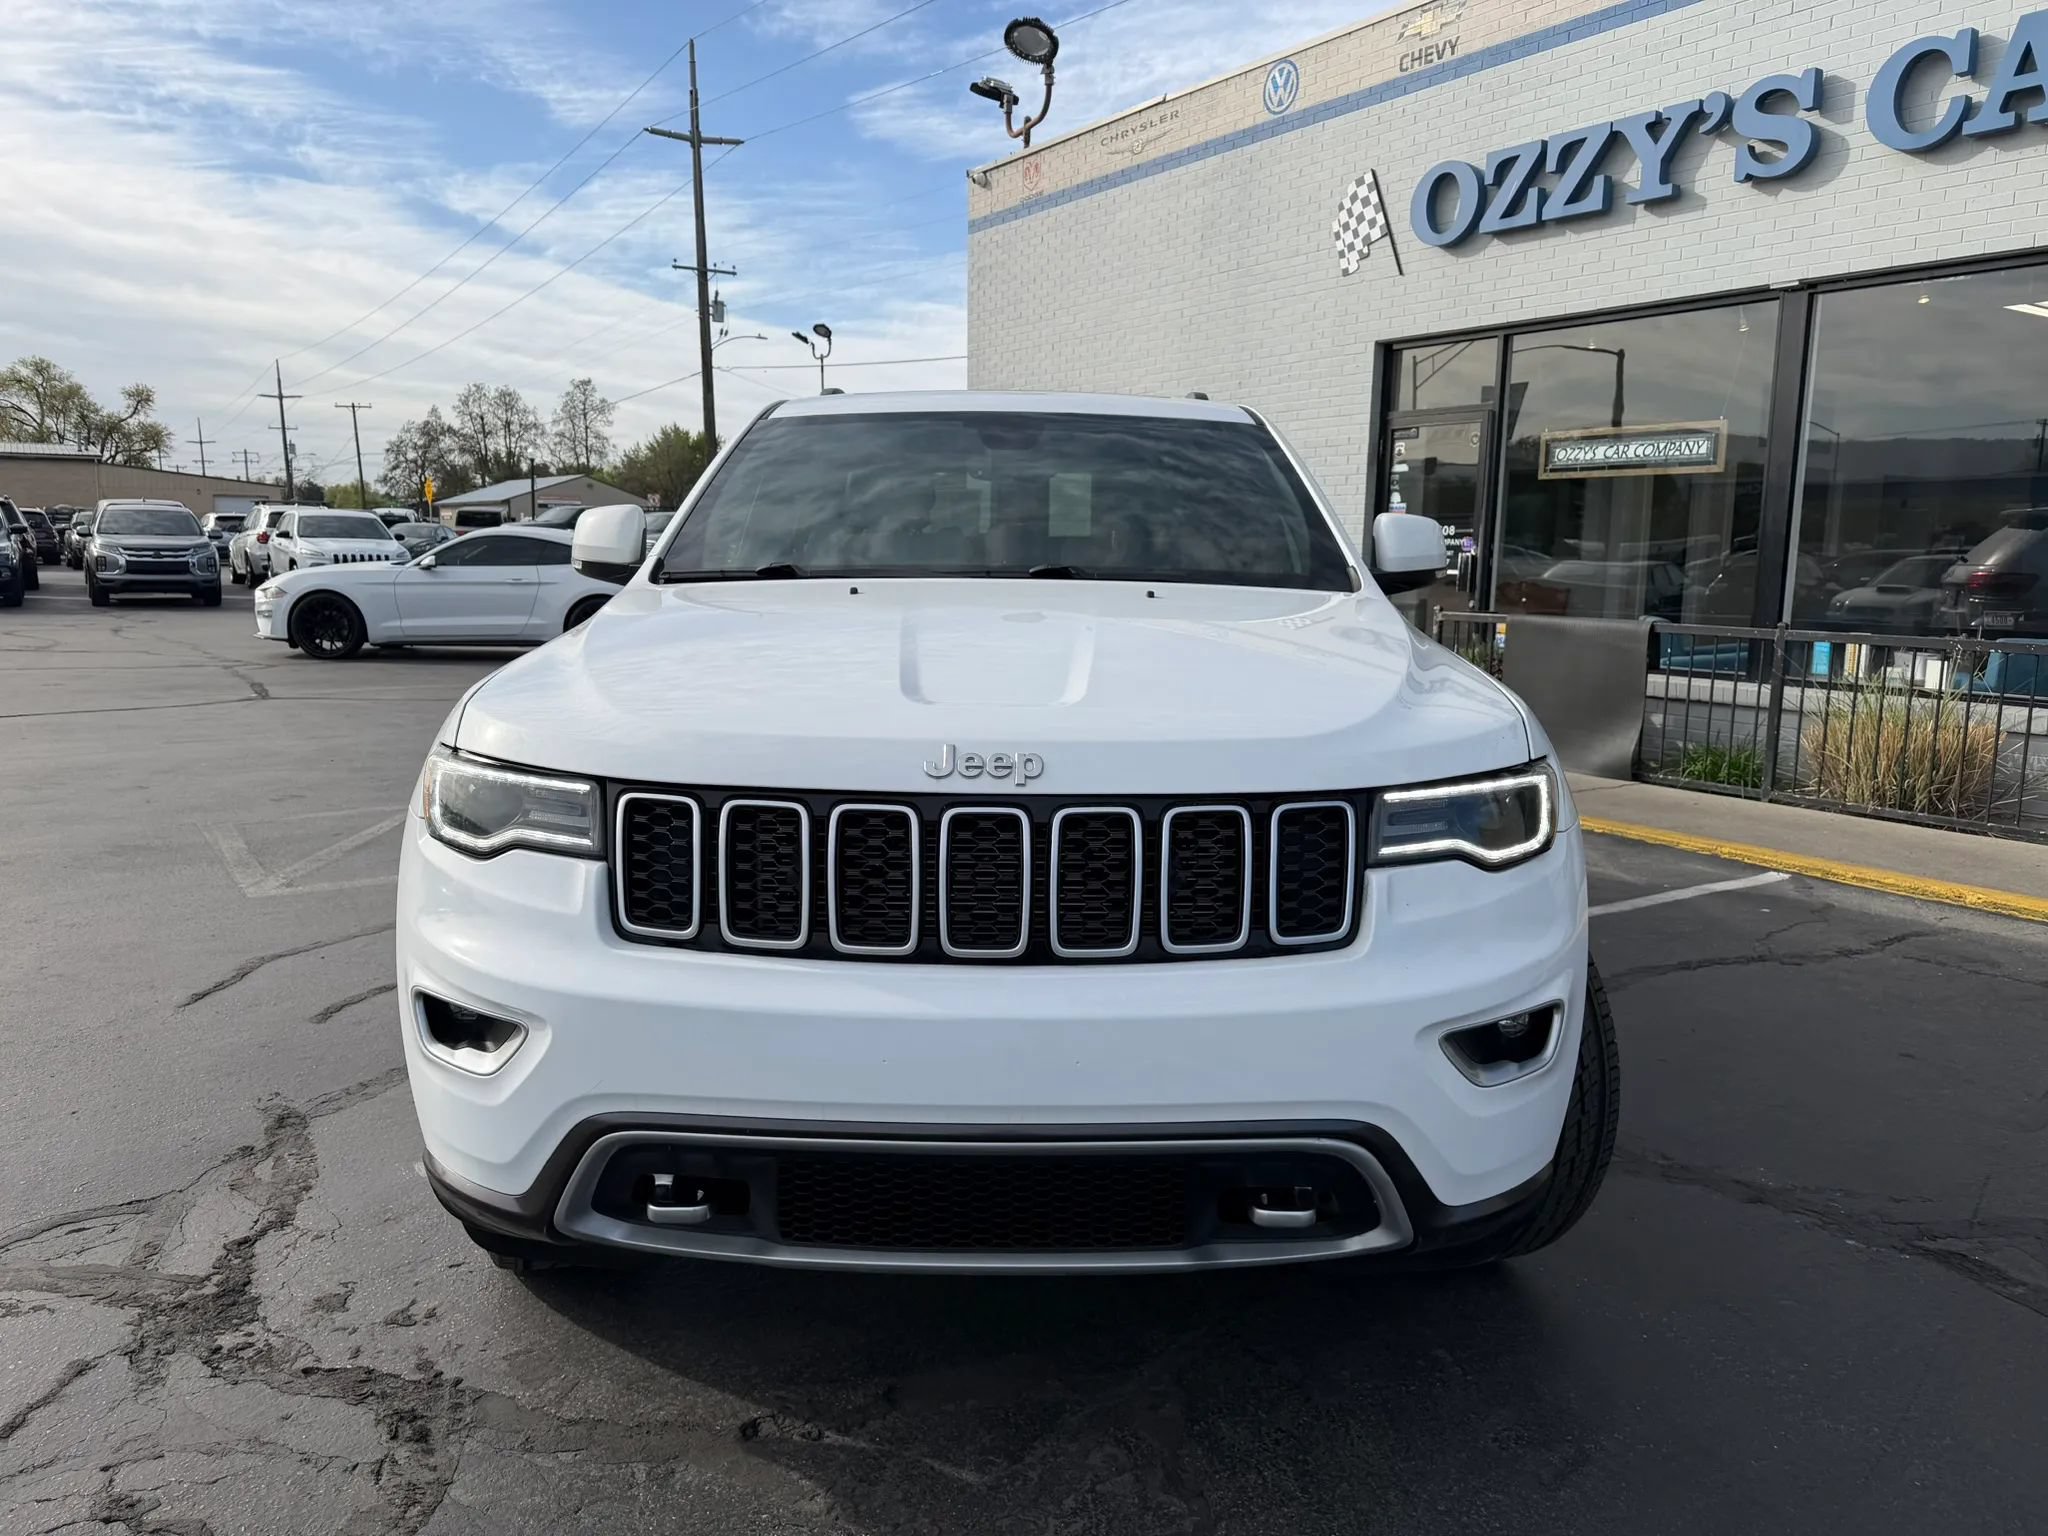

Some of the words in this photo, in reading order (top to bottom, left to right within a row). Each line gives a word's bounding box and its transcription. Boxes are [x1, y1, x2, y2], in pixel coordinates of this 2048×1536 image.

[1399, 35, 1460, 72] CHEVY
[1100, 109, 1180, 146] CHRYSLER
[1409, 67, 1823, 248] OZZY'S
[1866, 9, 2048, 154] CA
[1556, 446, 1597, 461] OZZY'S
[1603, 444, 1631, 459] CAR
[1634, 439, 1707, 458] COMPANY
[1441, 525, 1455, 536] 08
[923, 743, 1045, 787] Jeep
